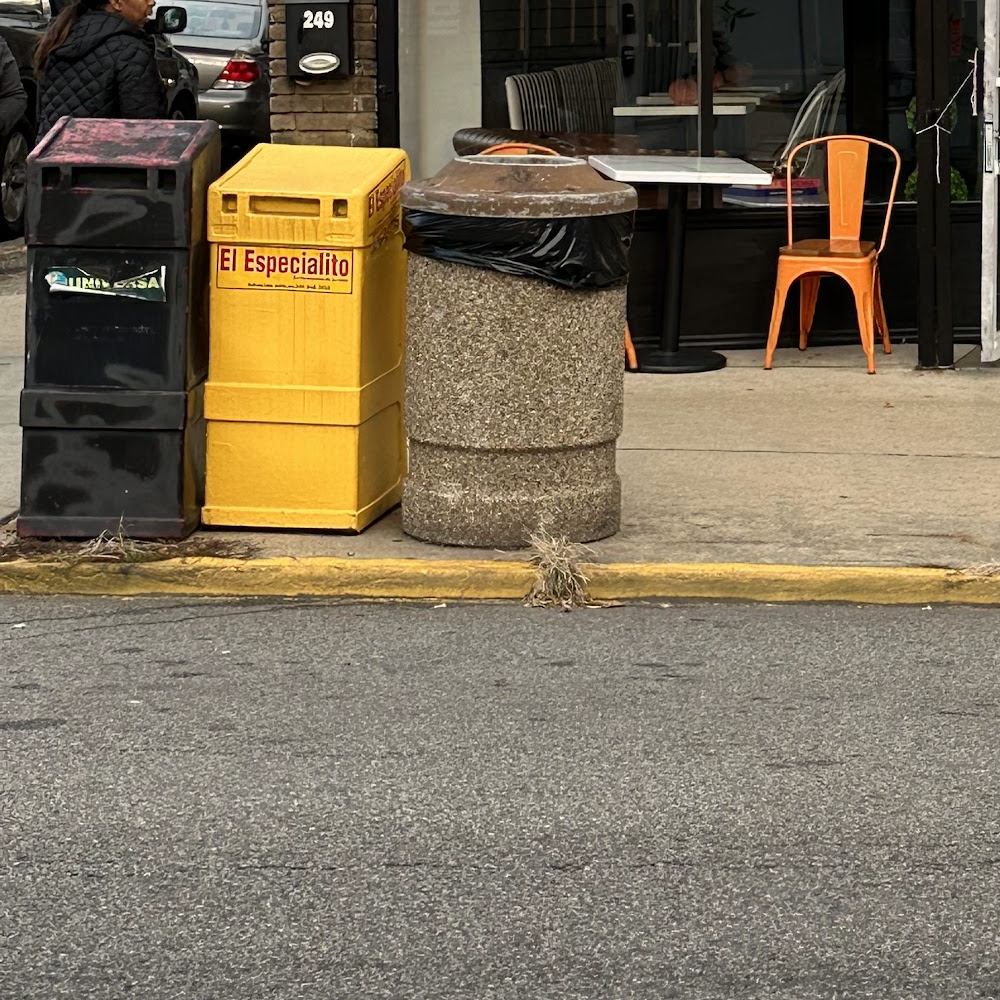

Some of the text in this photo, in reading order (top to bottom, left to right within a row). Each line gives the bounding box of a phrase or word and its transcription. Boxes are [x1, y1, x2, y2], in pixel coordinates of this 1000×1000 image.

[303, 10, 335, 29] 249
[220, 248, 349, 278] El Especialito
